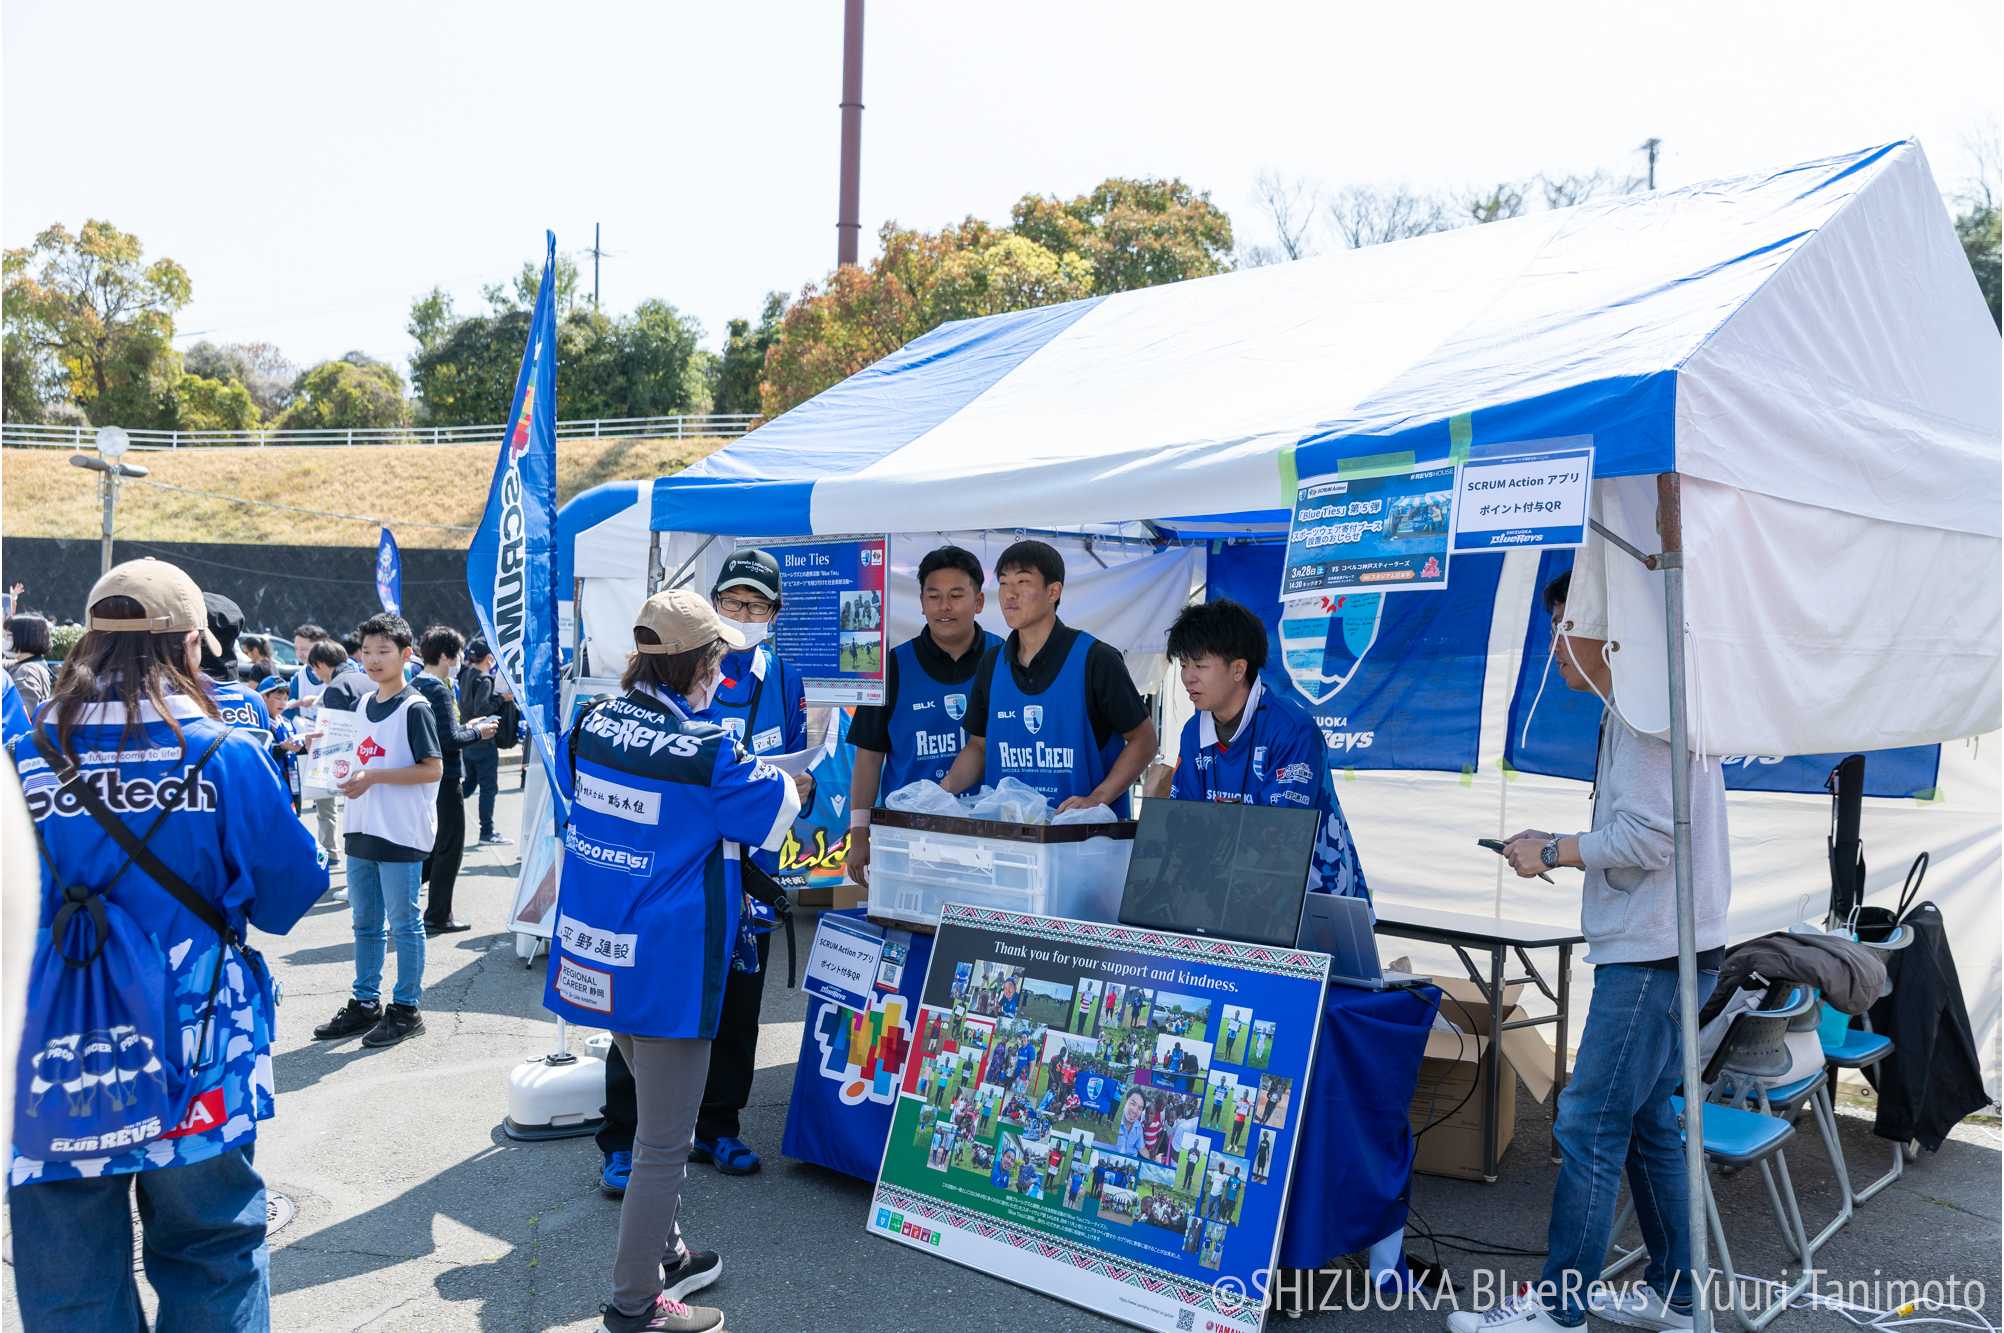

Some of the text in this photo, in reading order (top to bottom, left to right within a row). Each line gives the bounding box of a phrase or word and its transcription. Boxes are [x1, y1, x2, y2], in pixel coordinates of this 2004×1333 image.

[1467, 472, 1579, 491] SCRUM Action アプリ
[1480, 500, 1562, 516] ポイント付与QR
[785, 552, 830, 567] Blue Ties
[913, 700, 936, 710] BLK
[997, 710, 1016, 719] BLK
[1313, 716, 1348, 727] UOKA
[560, 926, 630, 959] 平野建設
[819, 938, 874, 963] SCRUM Action アプリ
[562, 965, 598, 986] REGIONAL
[820, 960, 861, 981] ポイント付与QR
[994, 941, 1239, 993] Thank you for your support and kindness.
[562, 977, 588, 993] CAREER
[99, 1119, 161, 1151] REVS
